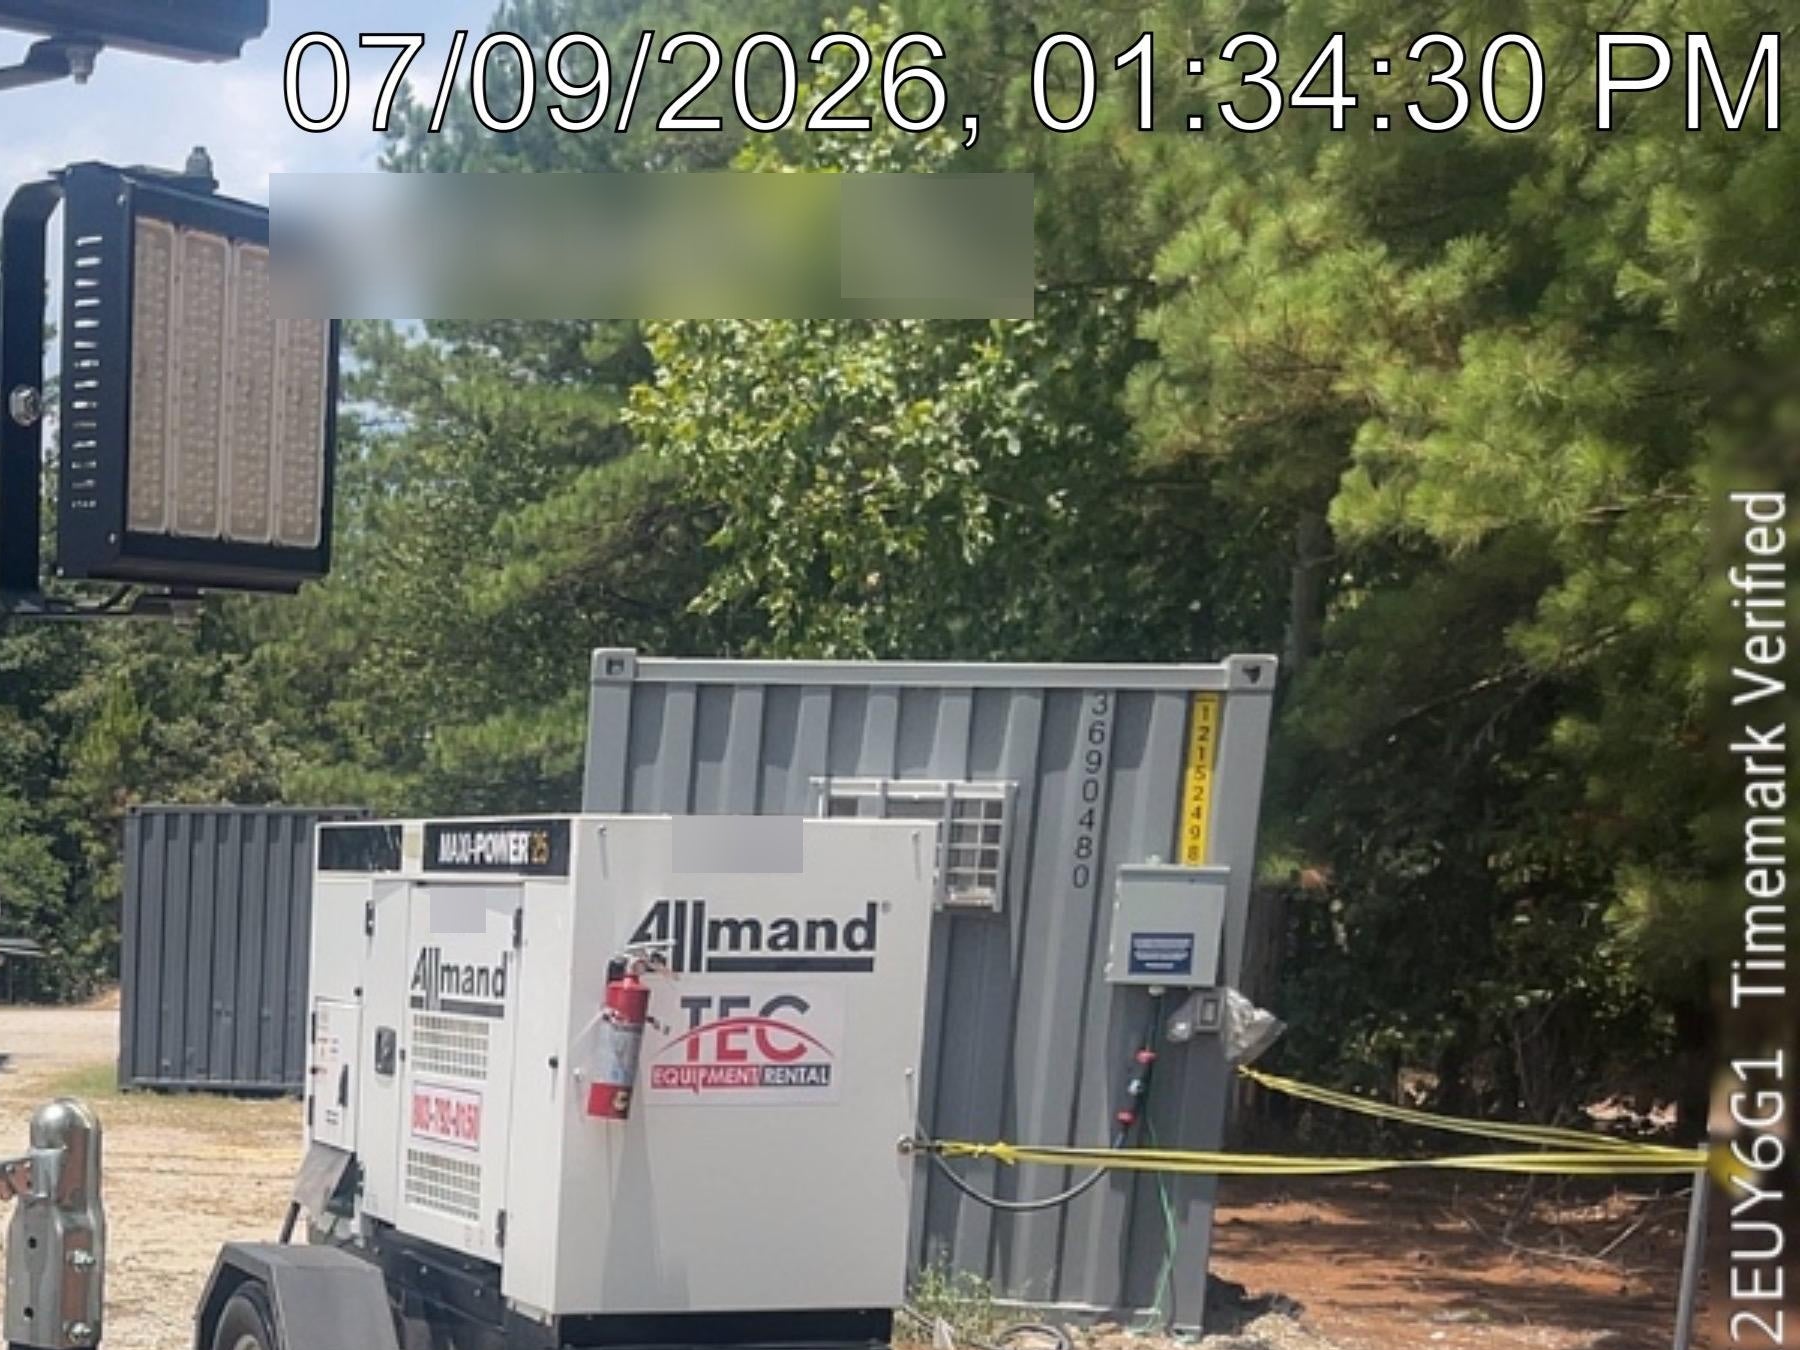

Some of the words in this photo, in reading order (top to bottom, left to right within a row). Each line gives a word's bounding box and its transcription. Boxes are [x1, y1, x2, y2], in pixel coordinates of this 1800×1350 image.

[626, 899, 878, 973] Allmand
[410, 947, 509, 1009] Allmand
[680, 994, 811, 1063] TEC
[653, 1065, 758, 1087] EQUIPMENT
[763, 1064, 829, 1086] RENTAL
